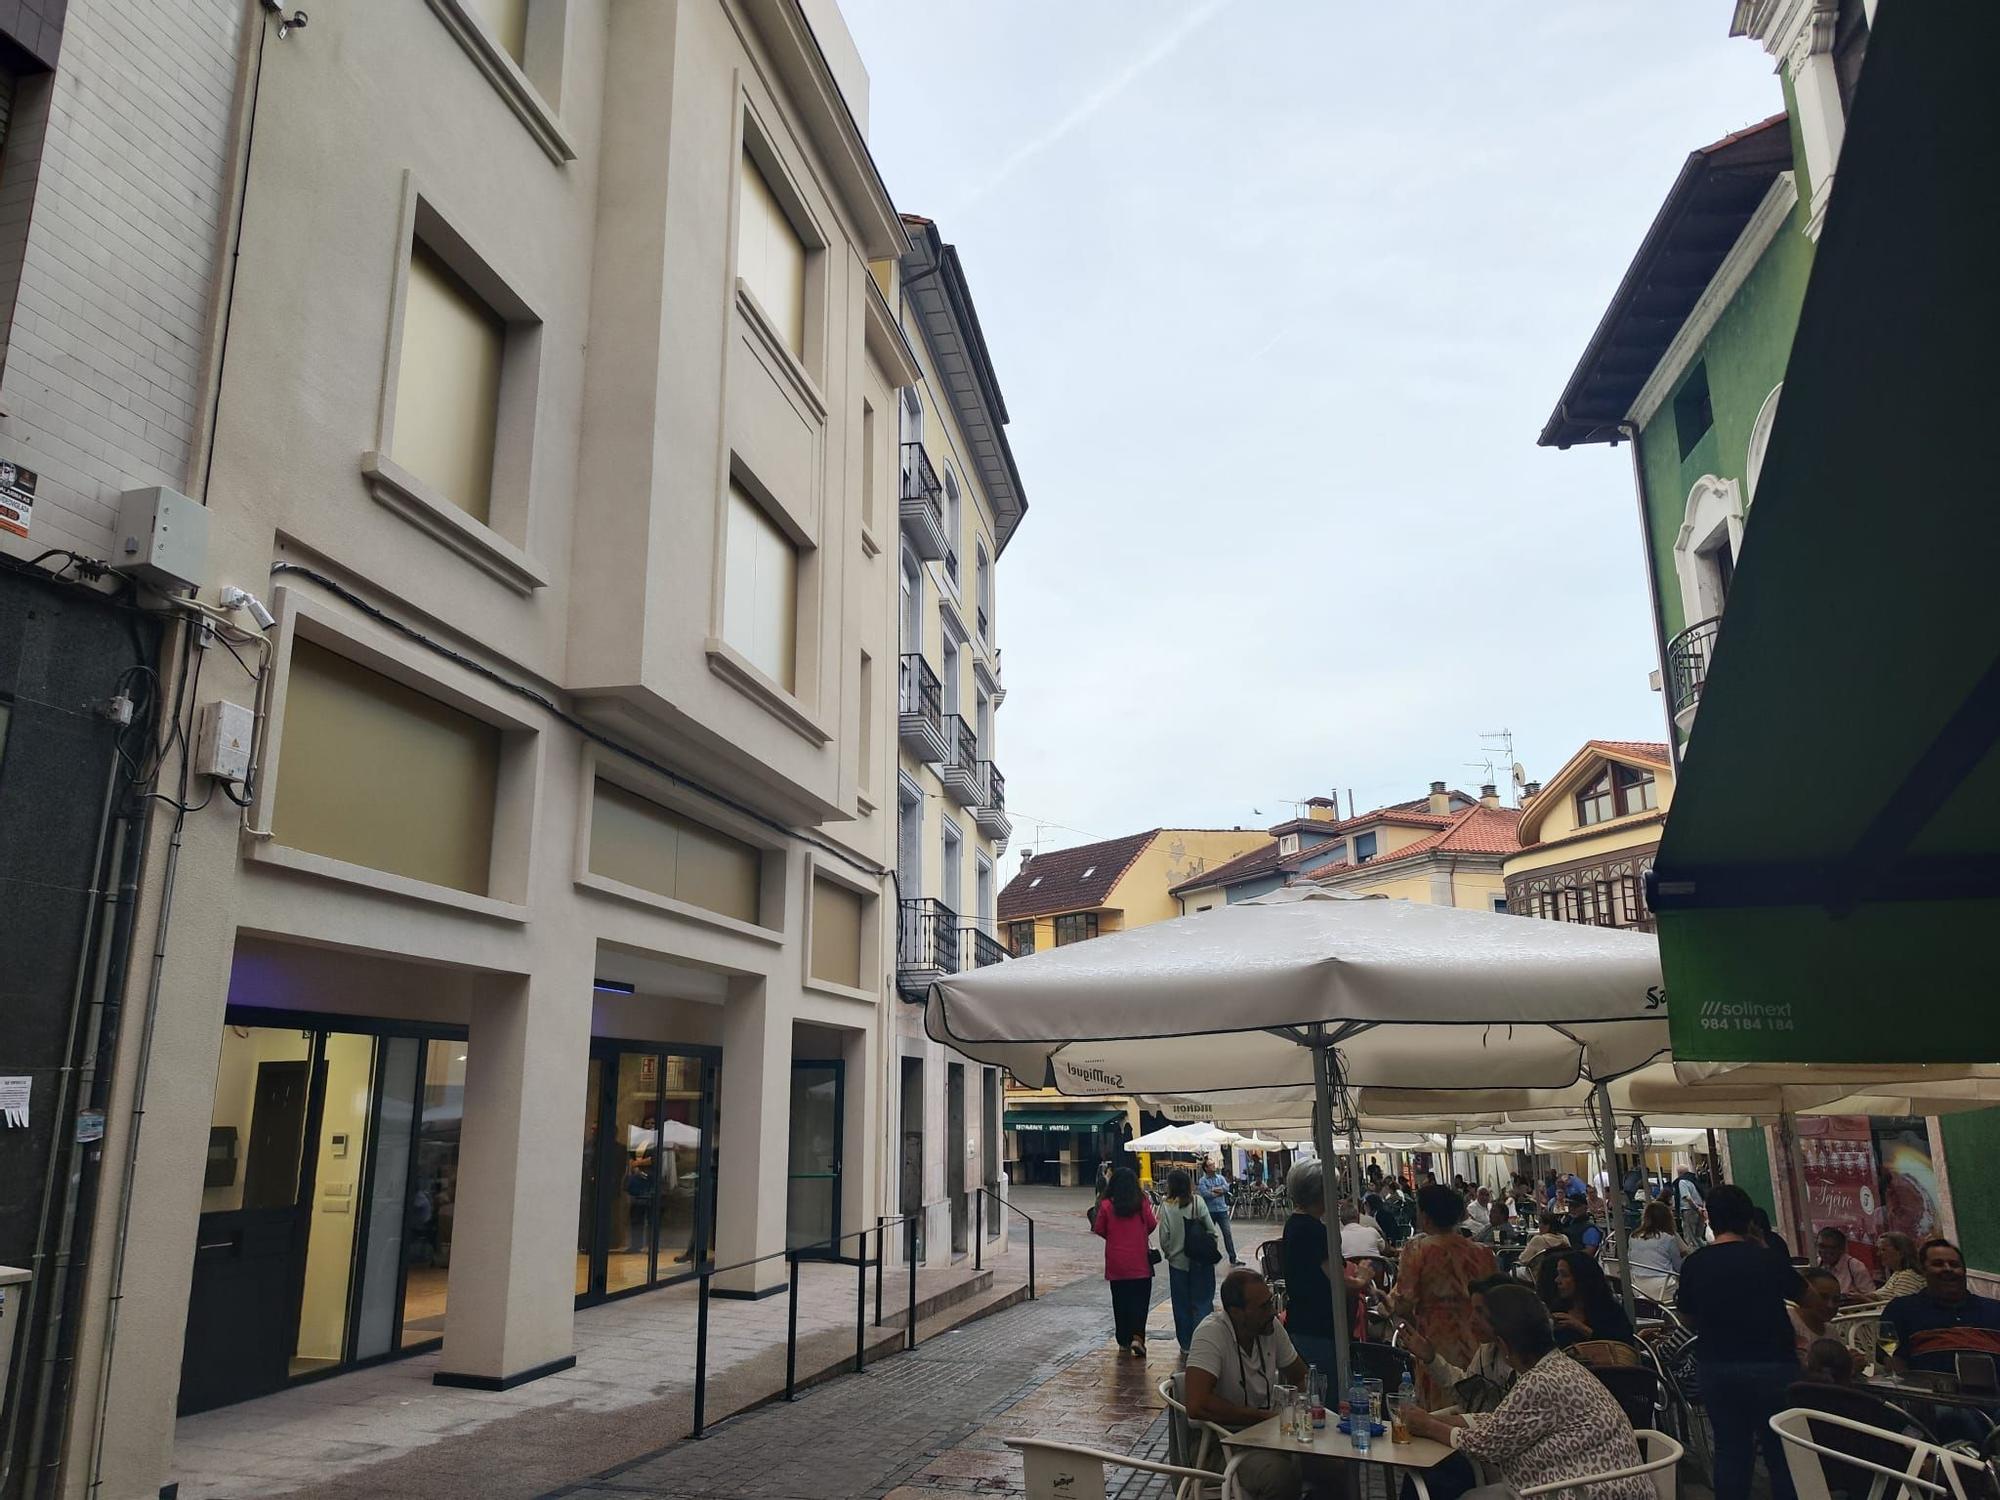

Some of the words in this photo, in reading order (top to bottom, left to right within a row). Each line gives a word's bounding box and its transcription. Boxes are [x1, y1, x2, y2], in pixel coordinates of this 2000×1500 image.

[1701, 1018, 1729, 1029] 984
[1735, 1018, 1762, 1030] 184
[1767, 1019, 1794, 1030] 184
